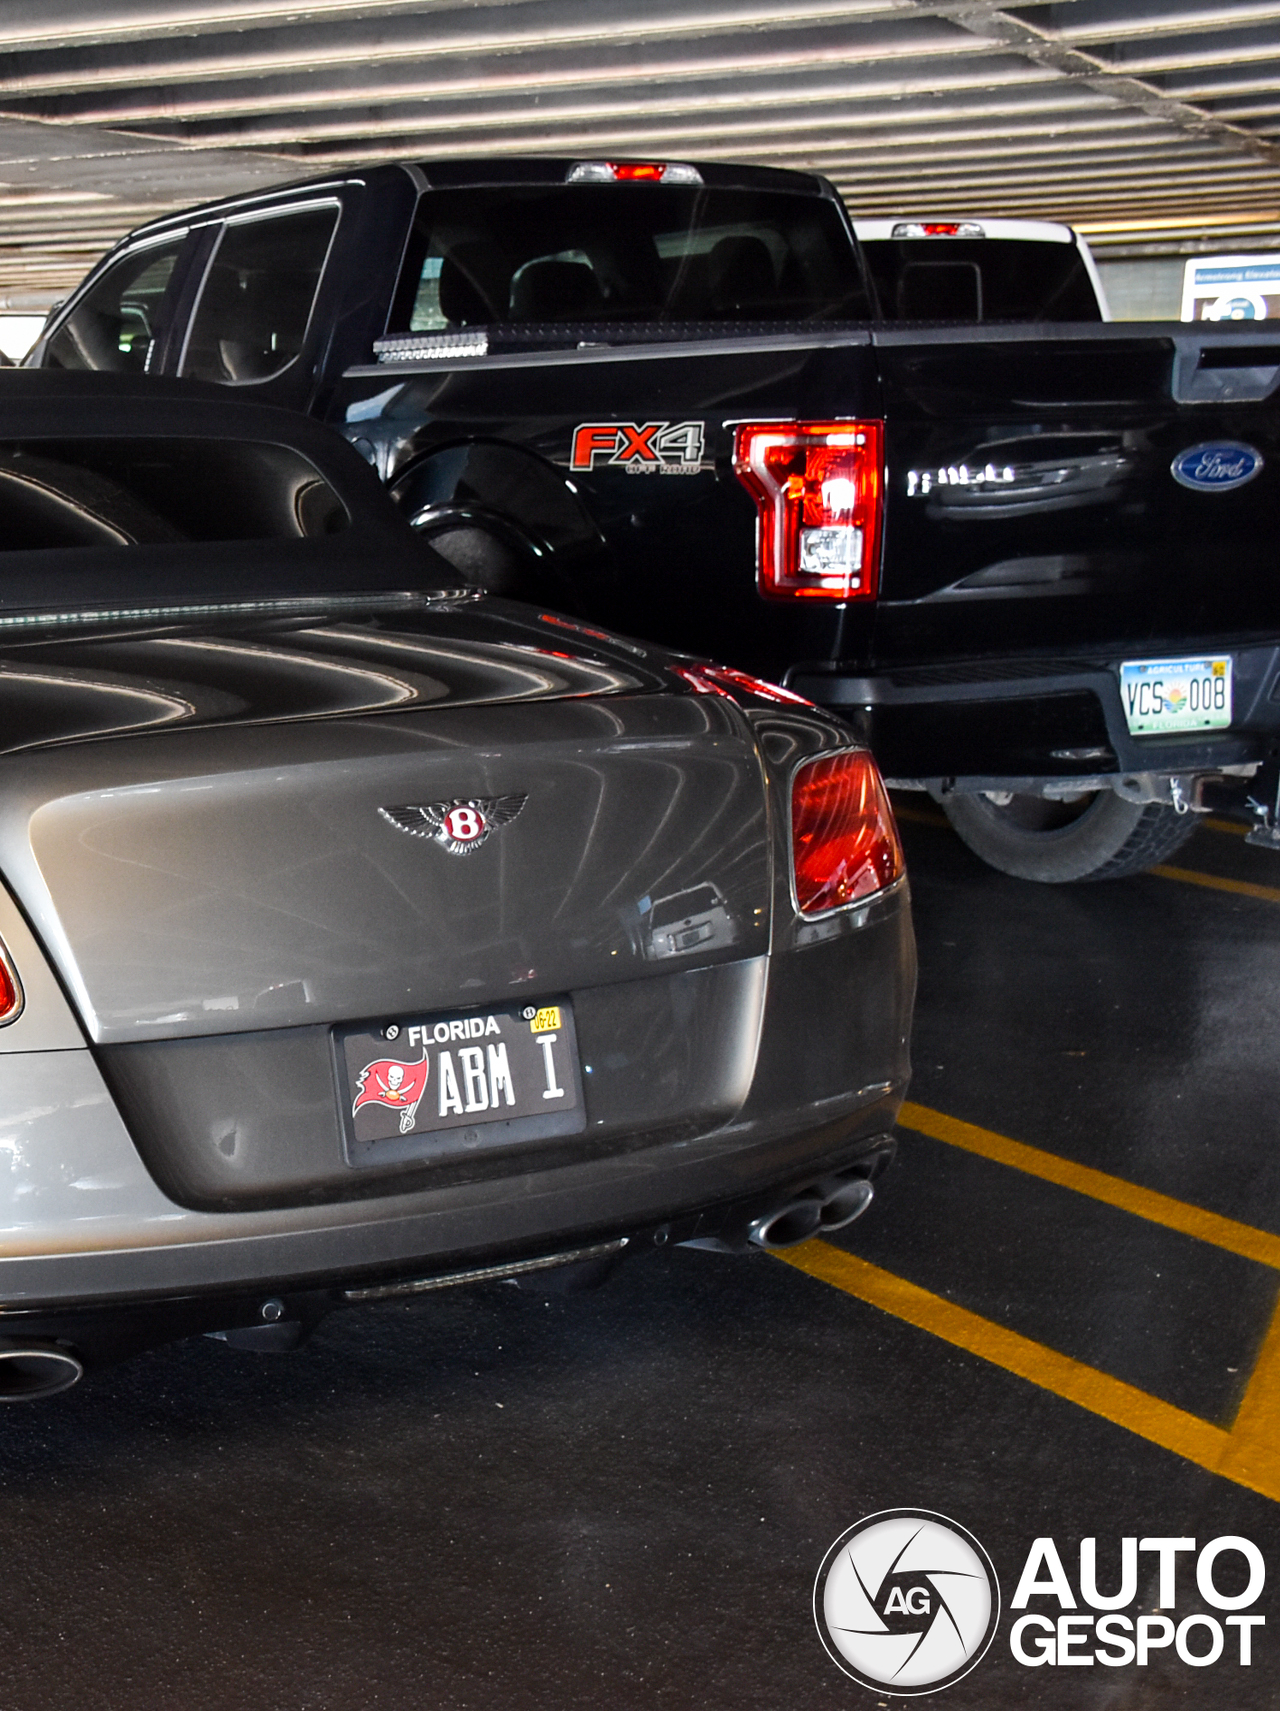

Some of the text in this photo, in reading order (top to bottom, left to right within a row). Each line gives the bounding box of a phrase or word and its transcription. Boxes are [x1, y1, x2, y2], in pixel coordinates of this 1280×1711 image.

[570, 421, 705, 471] FX4
[1194, 452, 1246, 479] Ford
[1147, 662, 1205, 675] AGRICULTURE
[408, 1015, 501, 1047] FLORIDA
[438, 1034, 565, 1117] ABM I
